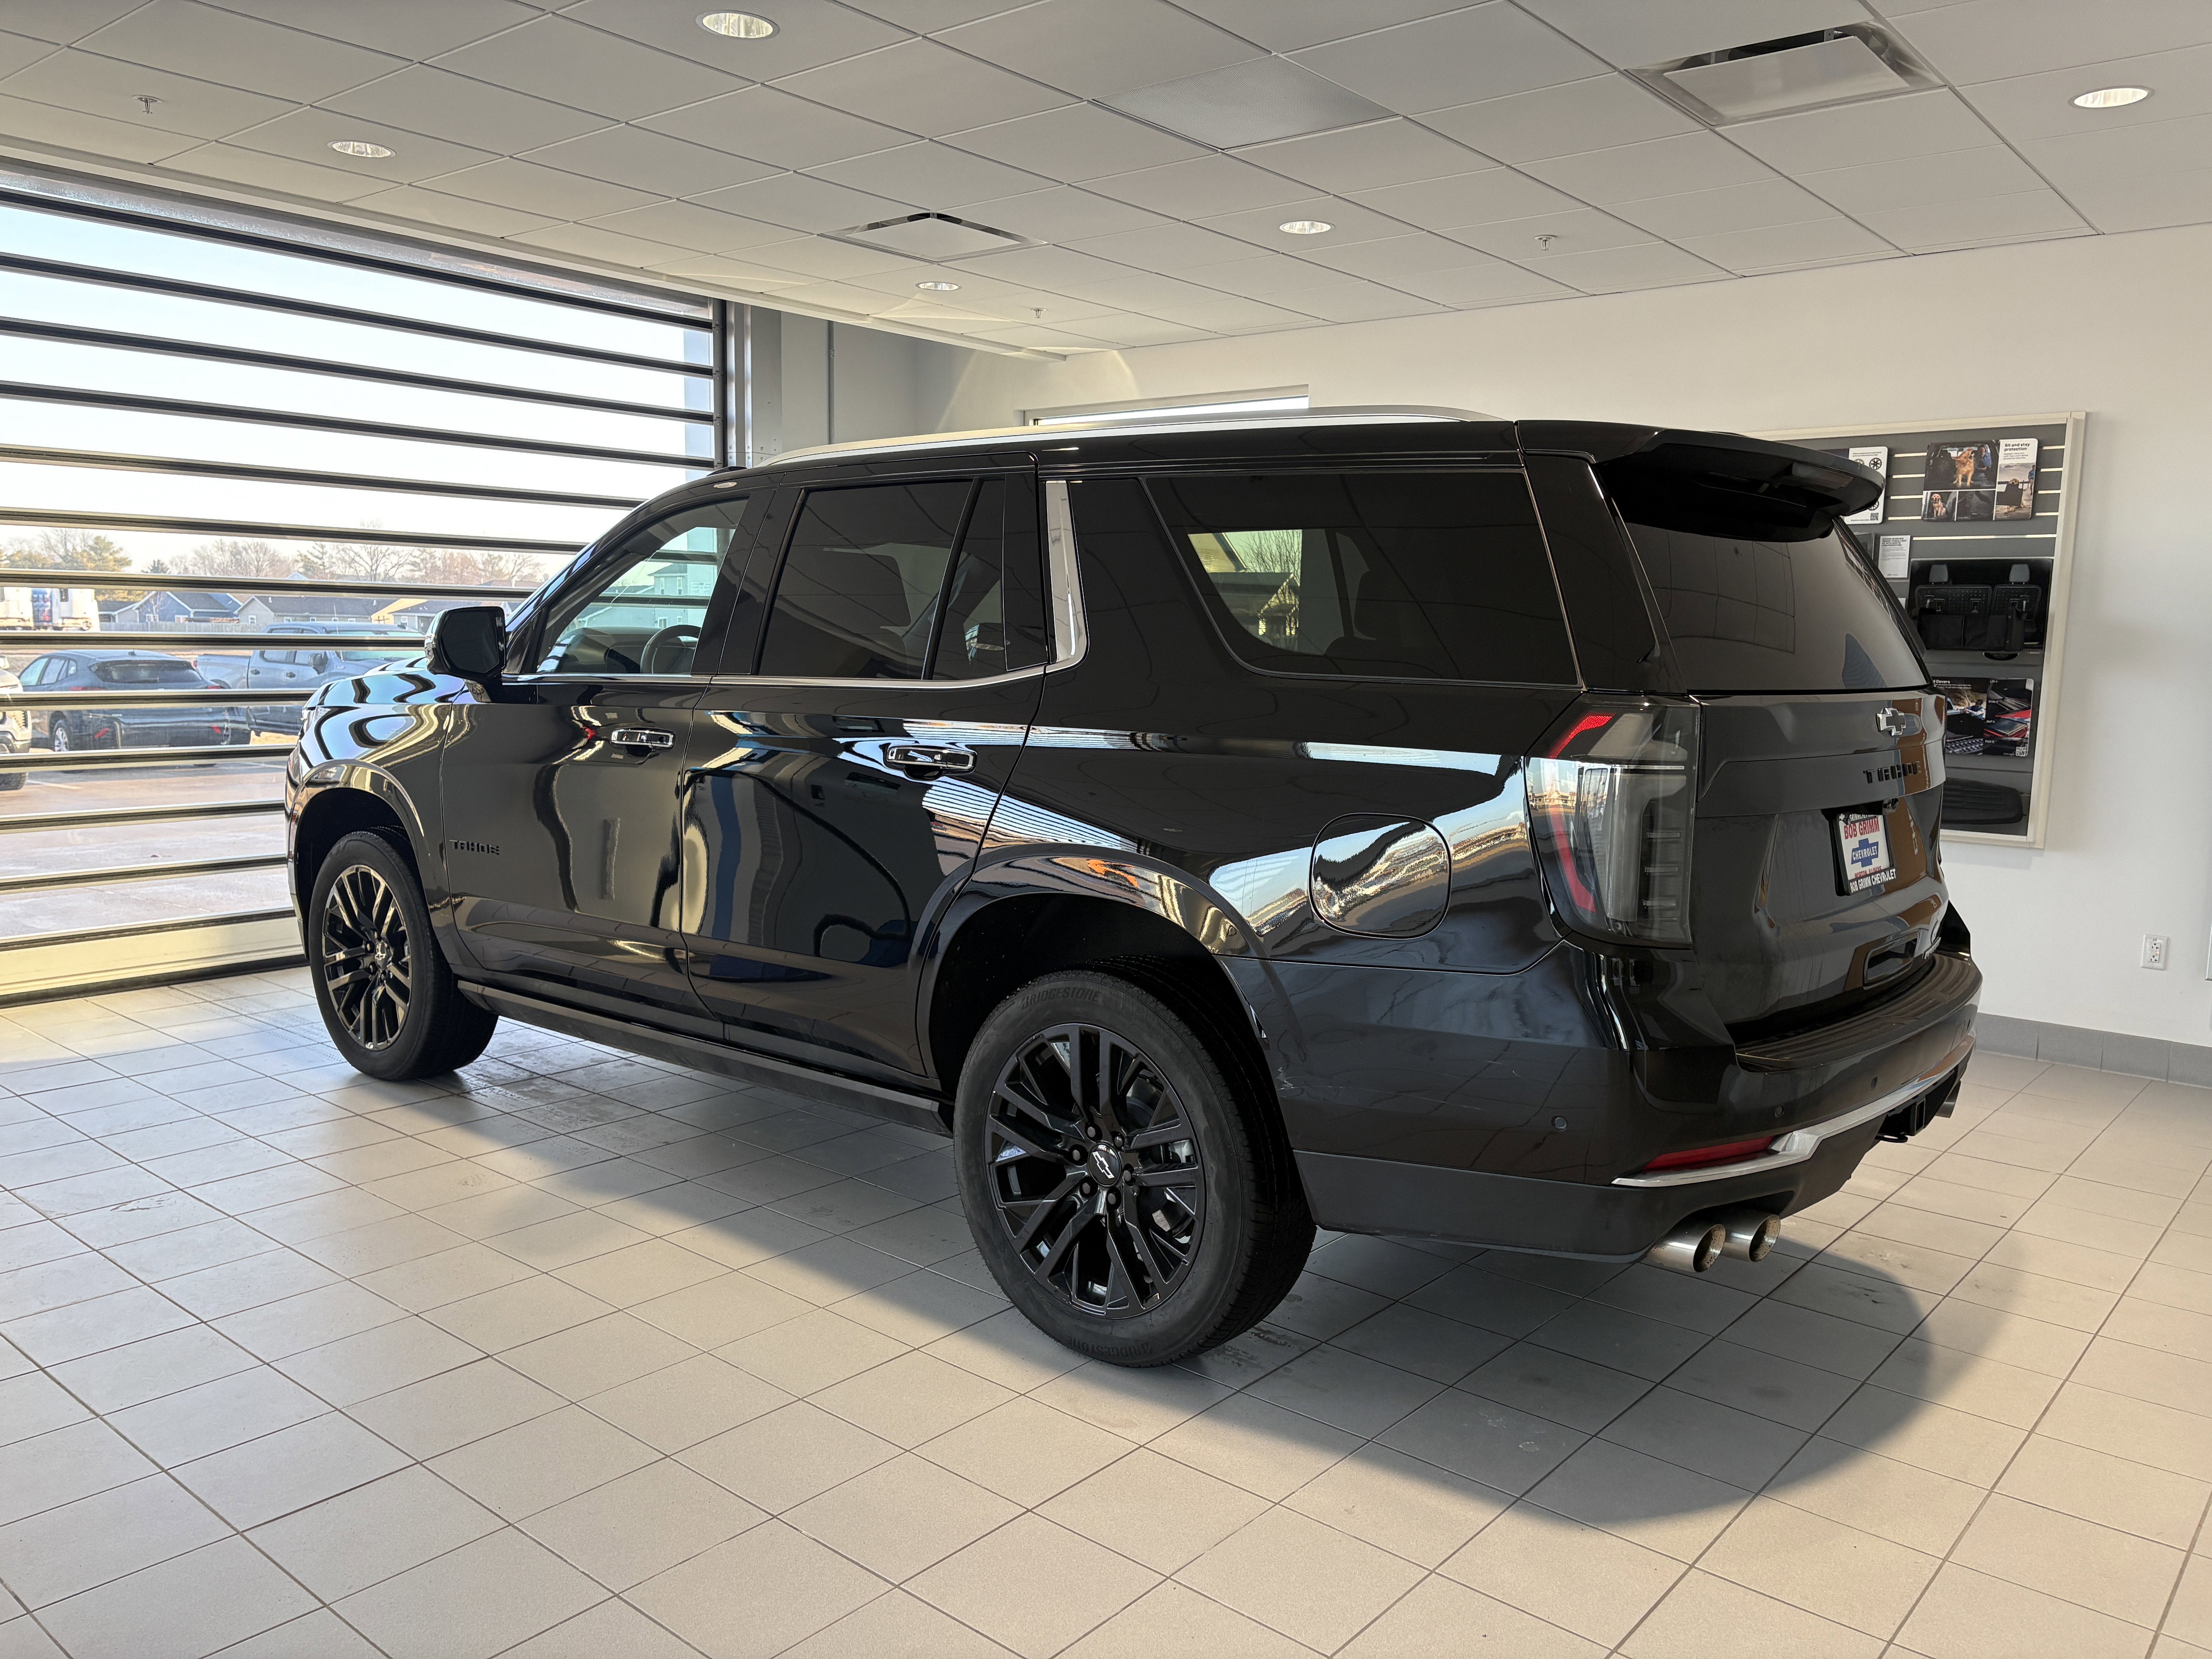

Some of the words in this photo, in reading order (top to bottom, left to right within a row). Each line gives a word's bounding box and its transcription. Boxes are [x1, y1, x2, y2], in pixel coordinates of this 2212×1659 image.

[1844, 823, 1857, 840] BOB
[1858, 817, 1880, 836] GRIMM
[449, 840, 500, 855] TAHOE
[1852, 846, 1877, 860] CHEVROLET
[1850, 880, 1859, 893] BOB
[1858, 876, 1872, 890] GRIMM
[1871, 868, 1896, 886] CHEVROLET
[1021, 987, 1103, 1010] BRIDGESTONE
[1067, 1335, 1154, 1358] BRIDGESTONE
